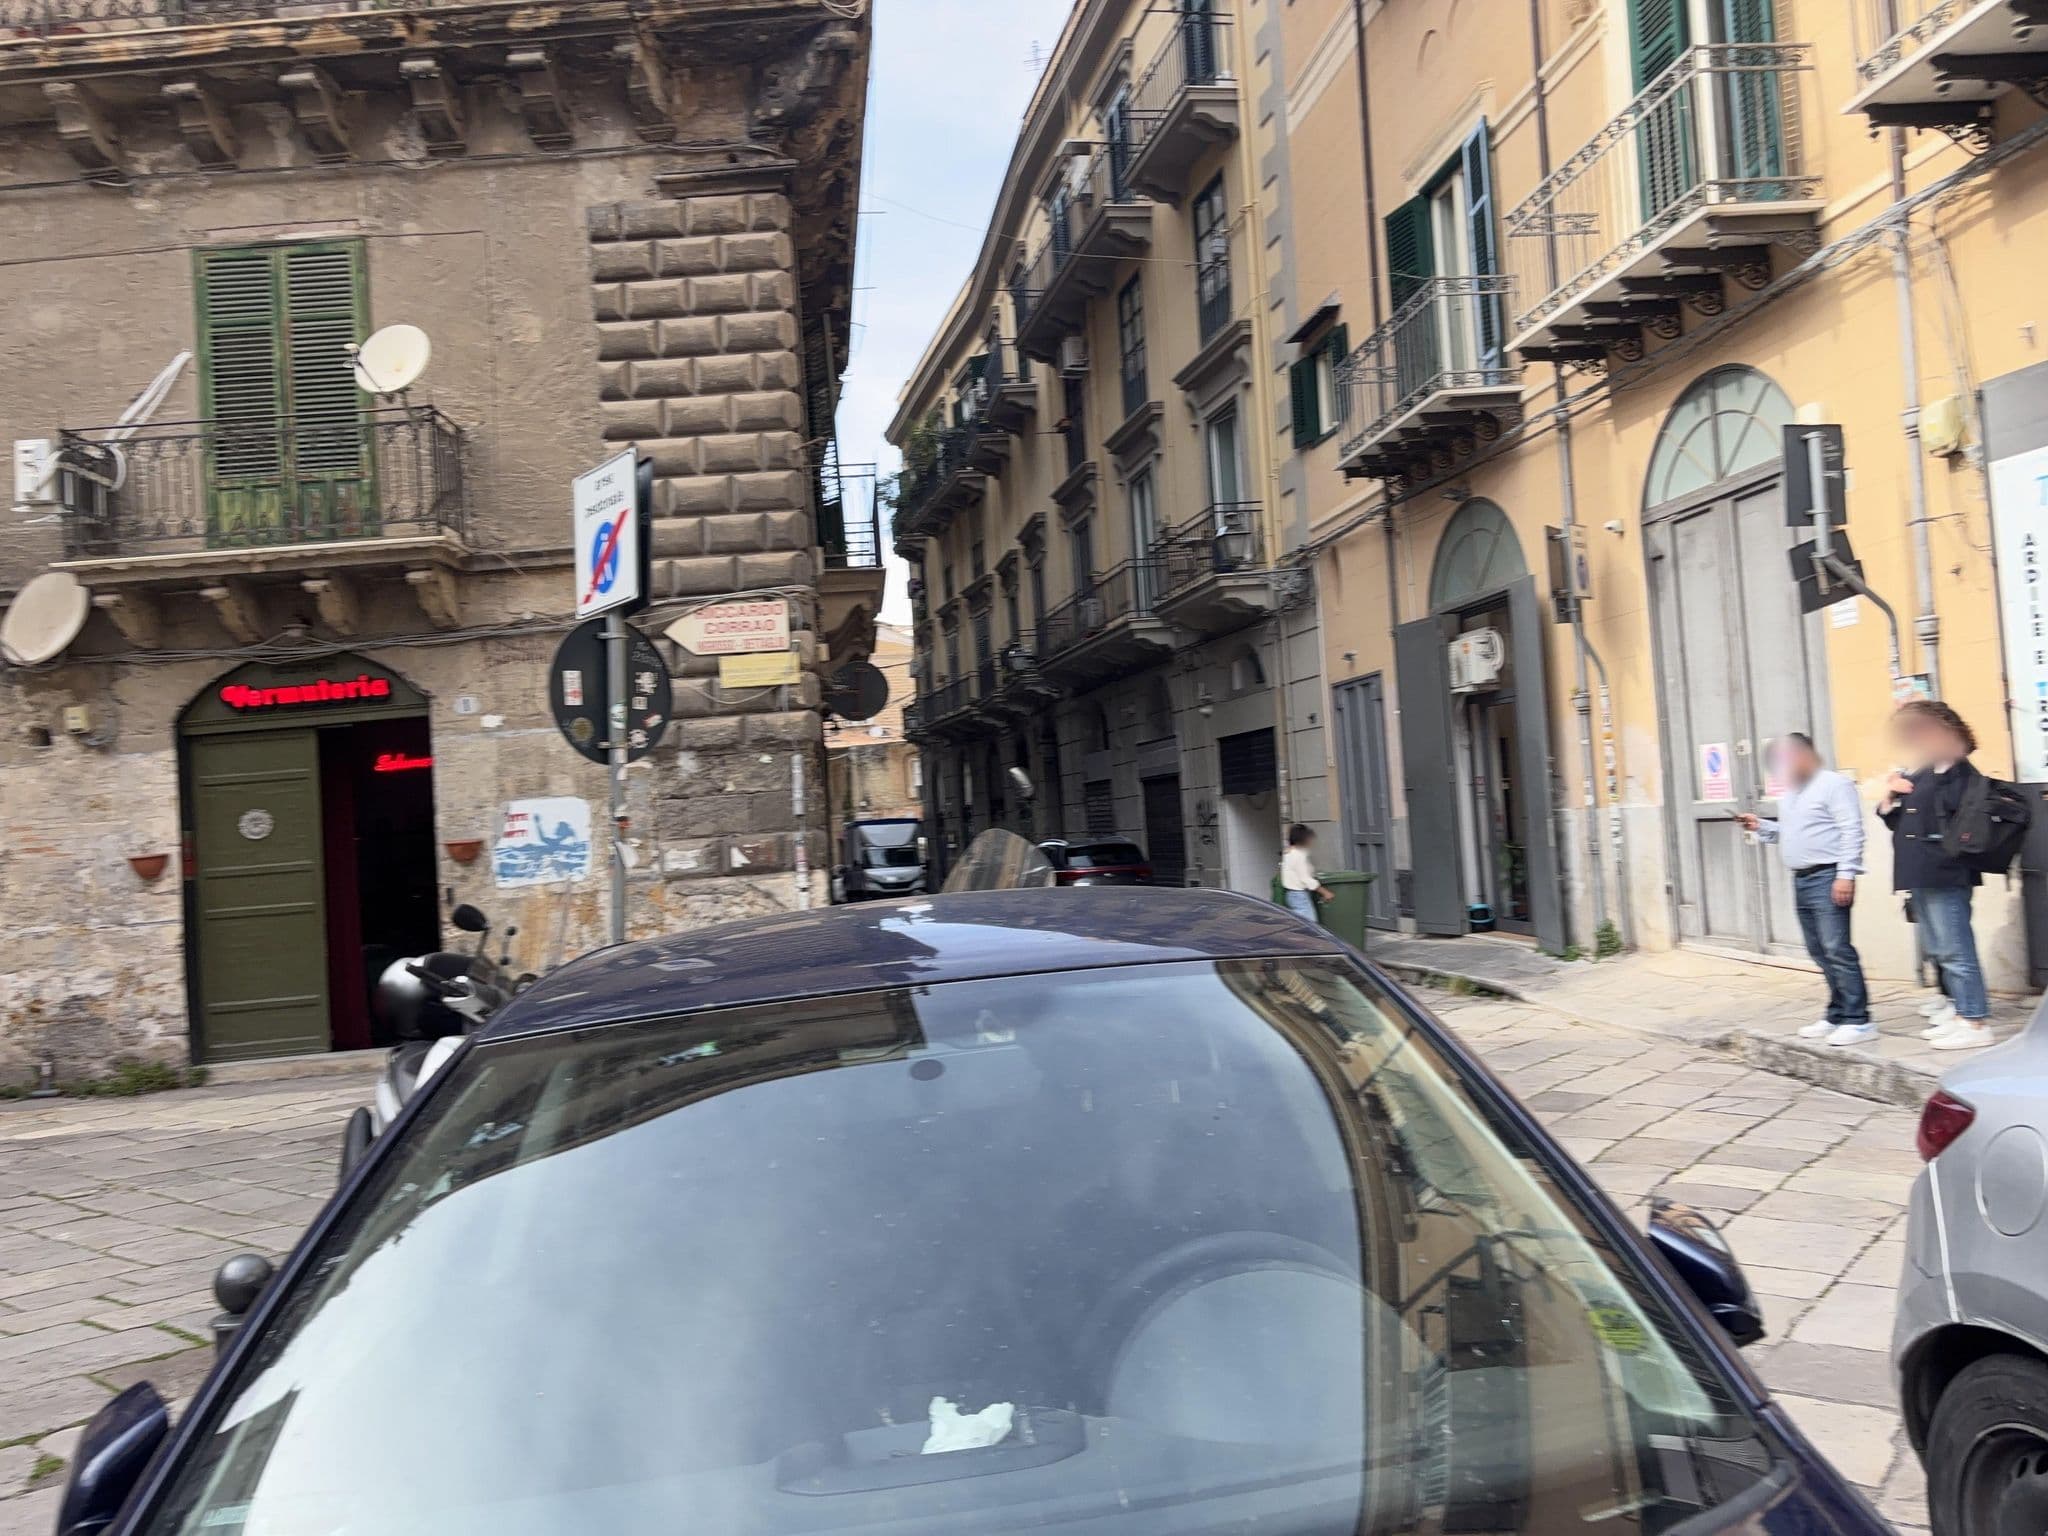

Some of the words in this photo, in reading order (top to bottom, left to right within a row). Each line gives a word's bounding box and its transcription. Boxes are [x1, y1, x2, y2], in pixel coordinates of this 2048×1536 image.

[2022, 532, 2046, 637] ARDILE
[704, 619, 776, 635] CORRAO
[2033, 650, 2047, 665] E
